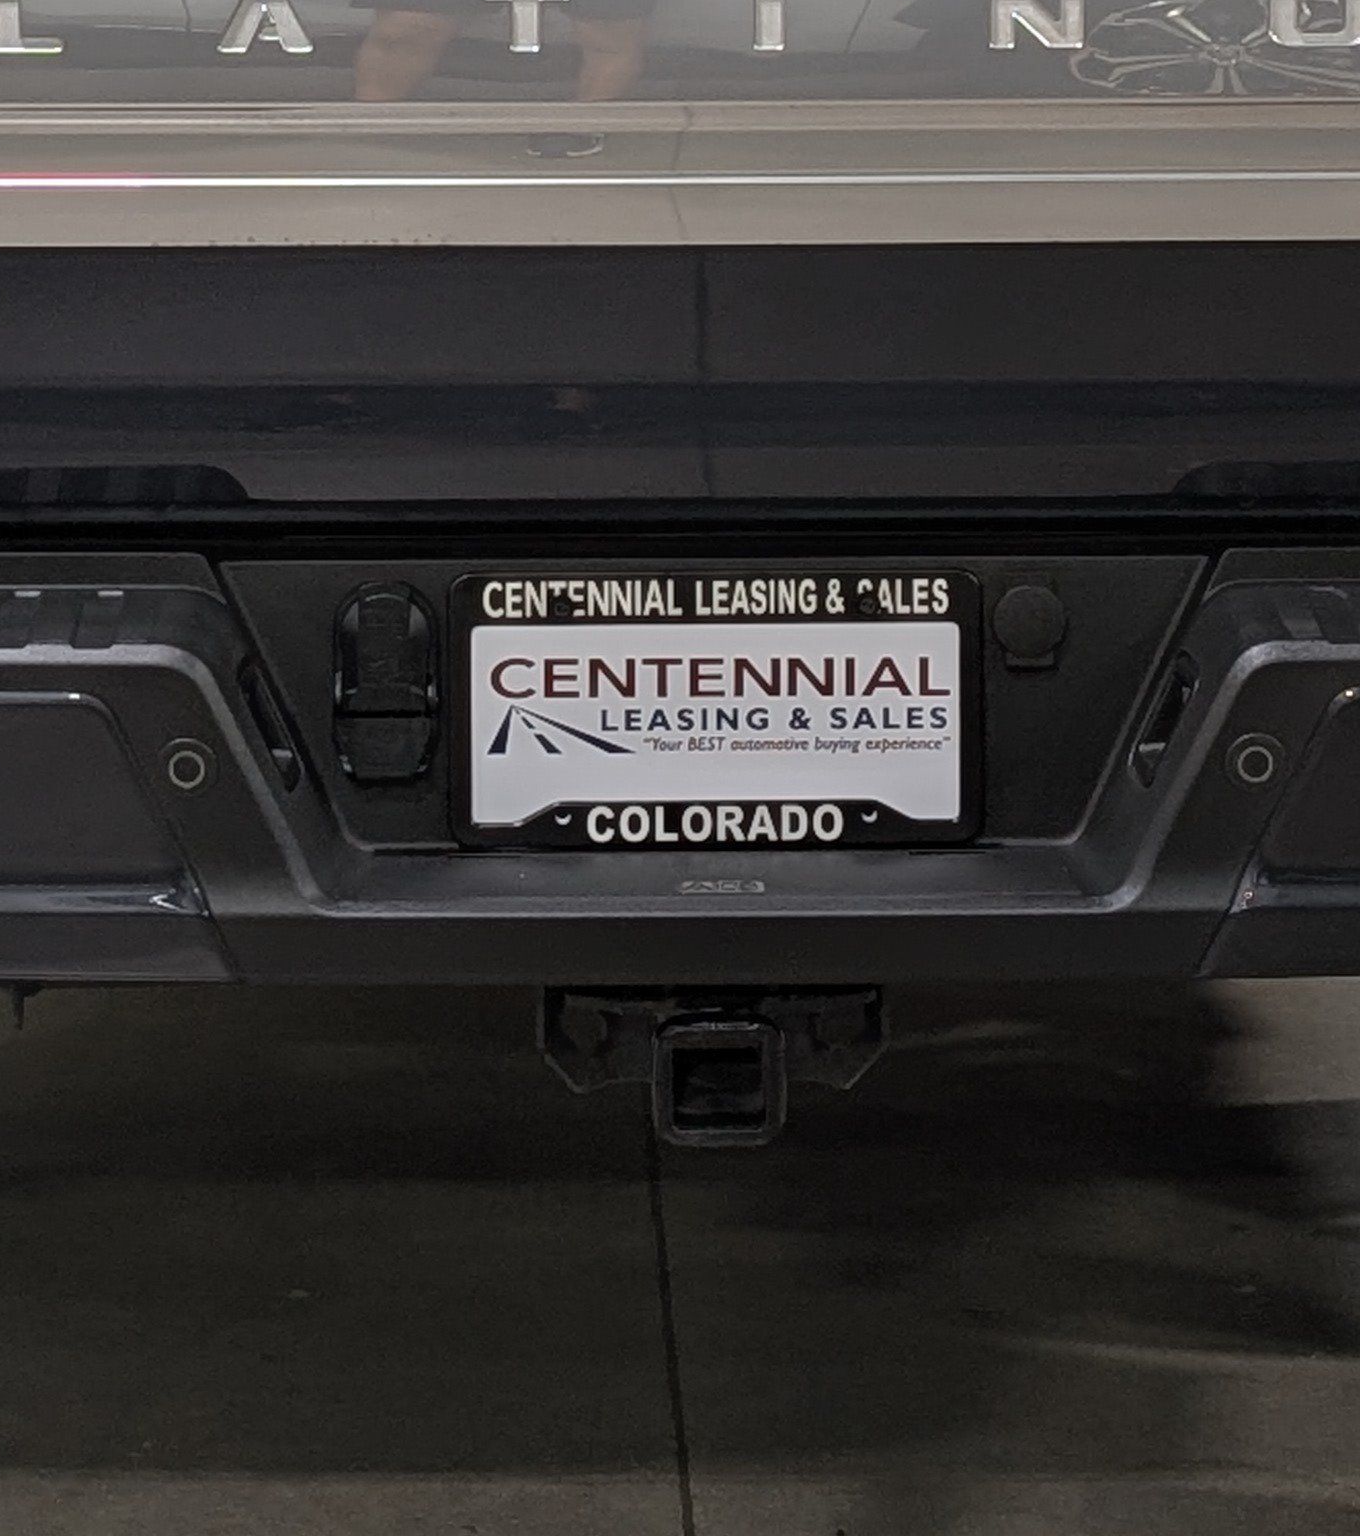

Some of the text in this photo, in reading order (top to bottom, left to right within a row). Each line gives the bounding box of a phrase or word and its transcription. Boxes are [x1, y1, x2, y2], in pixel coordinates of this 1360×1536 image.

[695, 579, 816, 616] LEASING
[825, 580, 845, 614] &
[490, 657, 951, 700] CENTENNIAL
[601, 706, 948, 732] LEASING & SALES
[687, 736, 725, 752] BEST
[730, 737, 809, 752] automotive
[814, 736, 860, 754] buying
[586, 804, 845, 843] COLORADO
